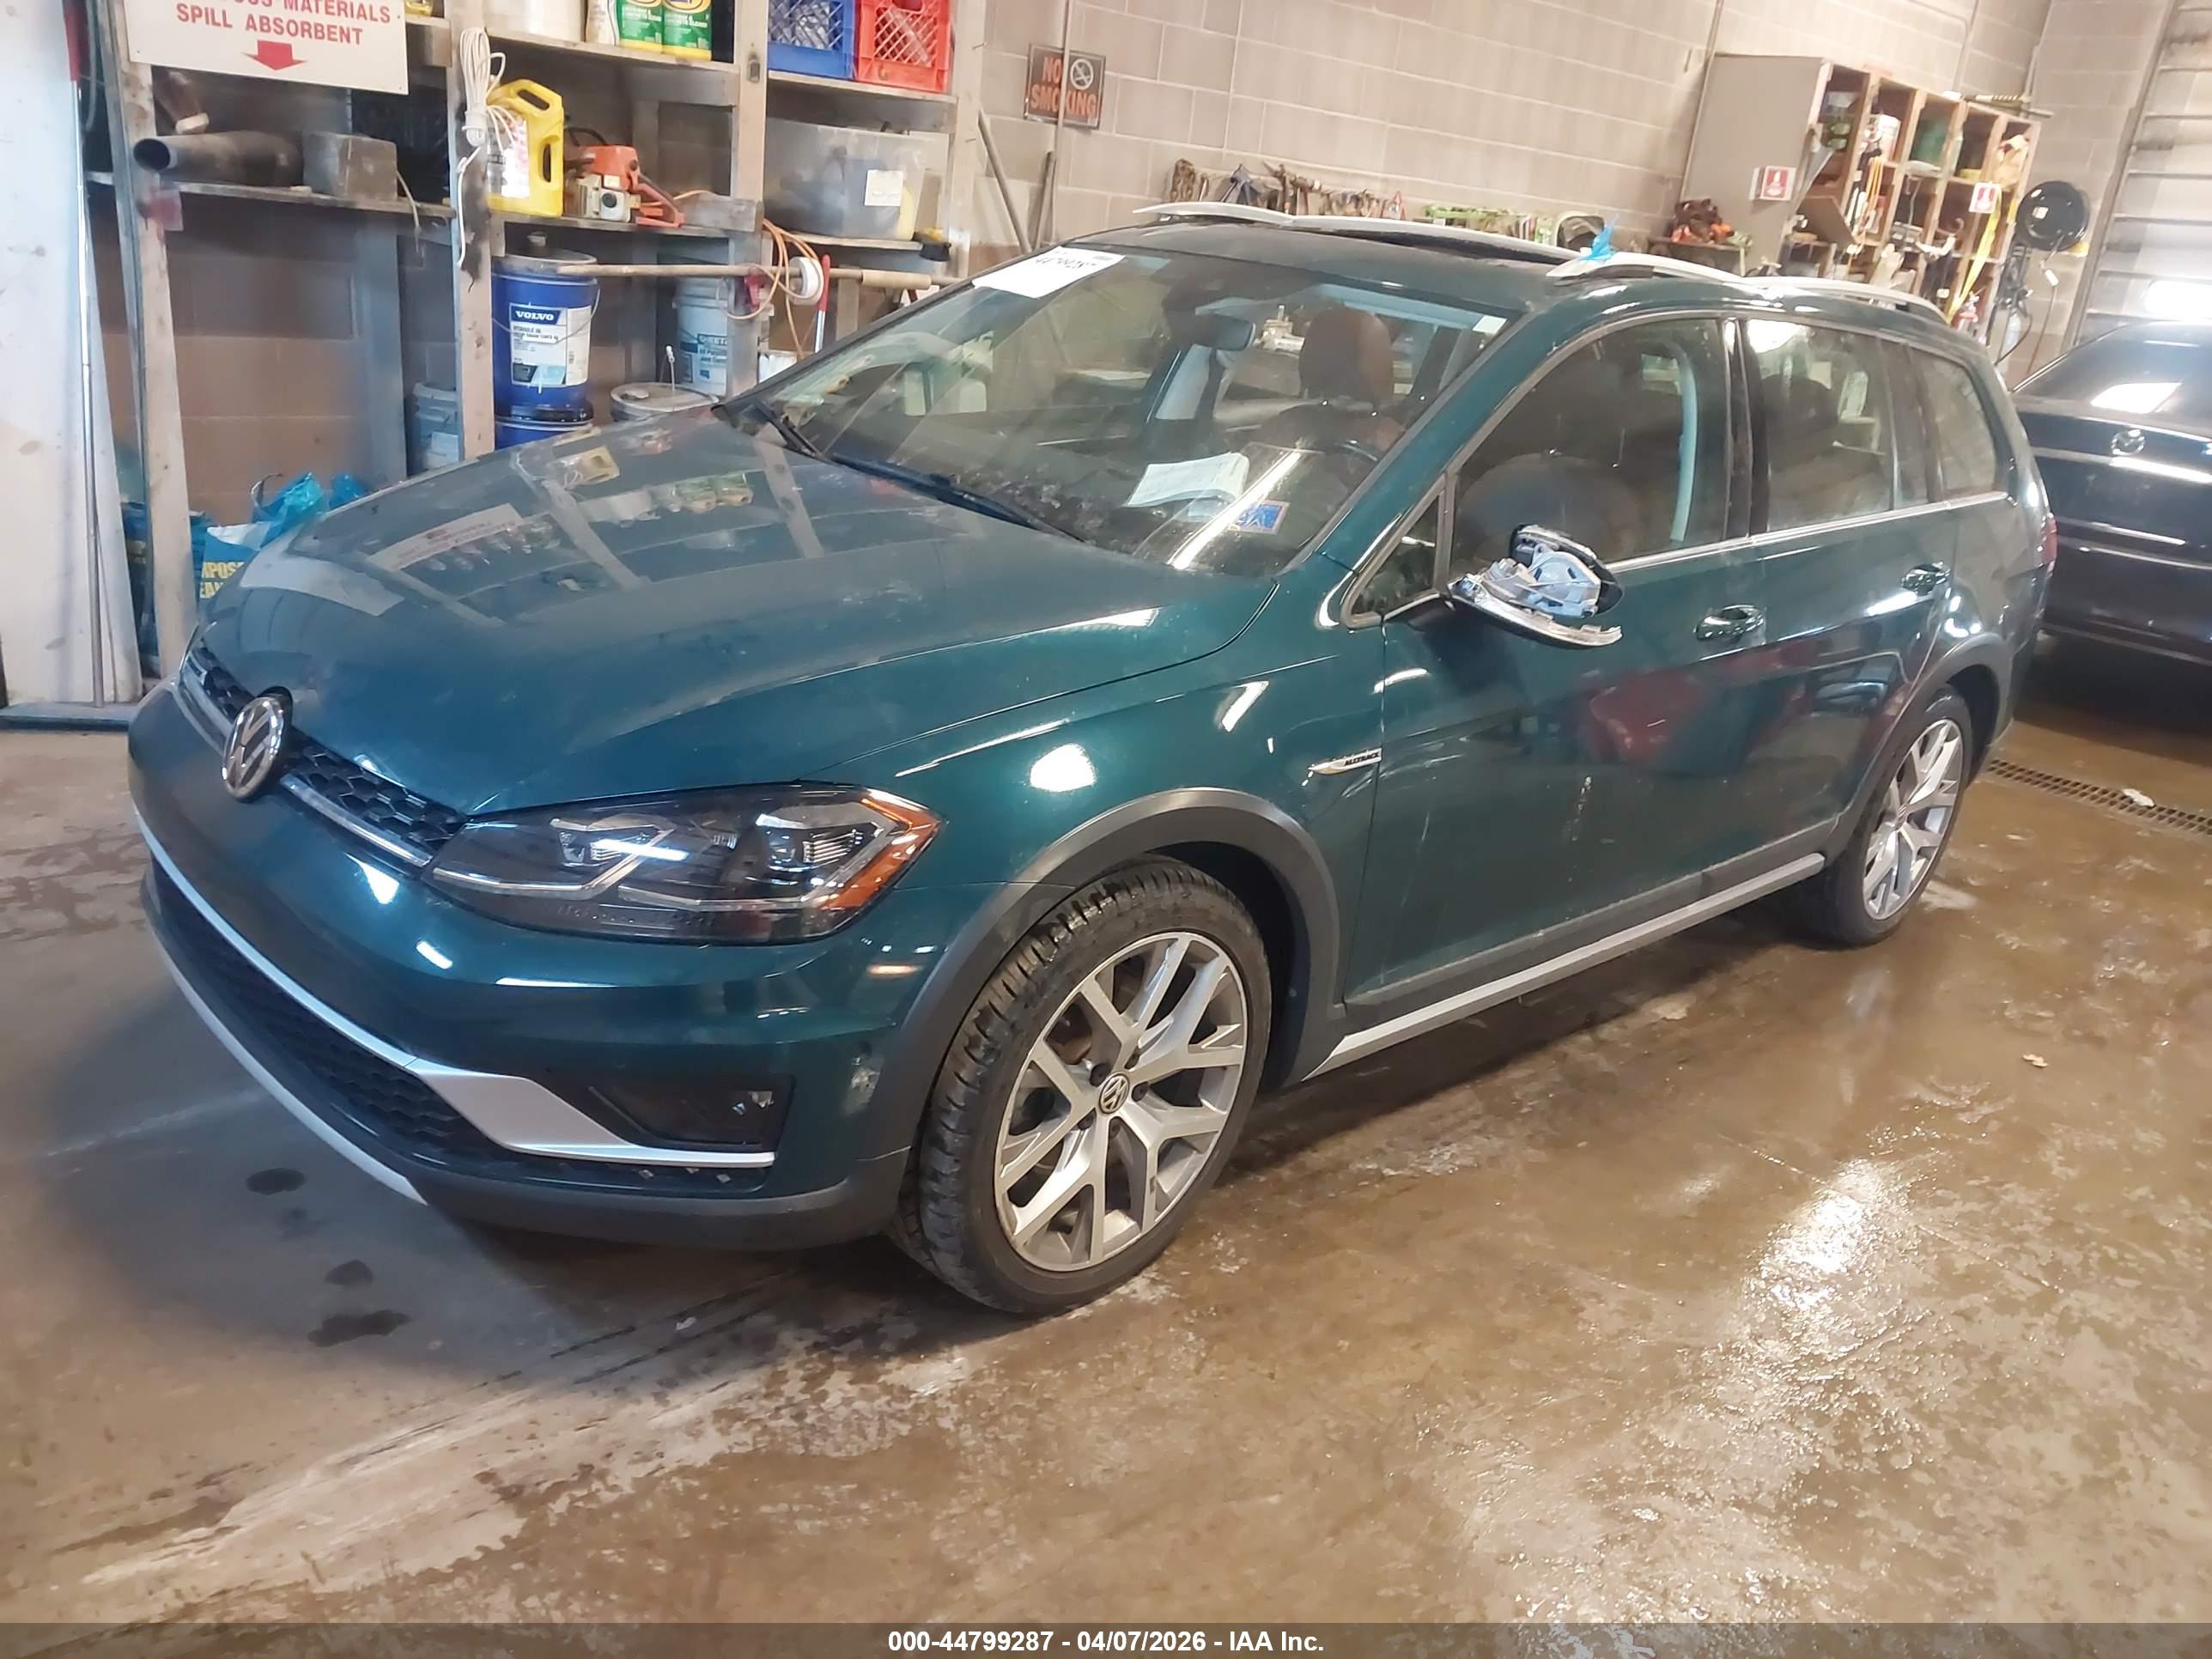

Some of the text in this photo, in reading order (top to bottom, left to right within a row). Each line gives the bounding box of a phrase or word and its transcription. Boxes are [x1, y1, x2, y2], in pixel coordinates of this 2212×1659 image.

[176, 3, 363, 45] SPILL ABSORBENT
[1042, 56, 1062, 83] NO
[515, 310, 555, 321] VOLVO
